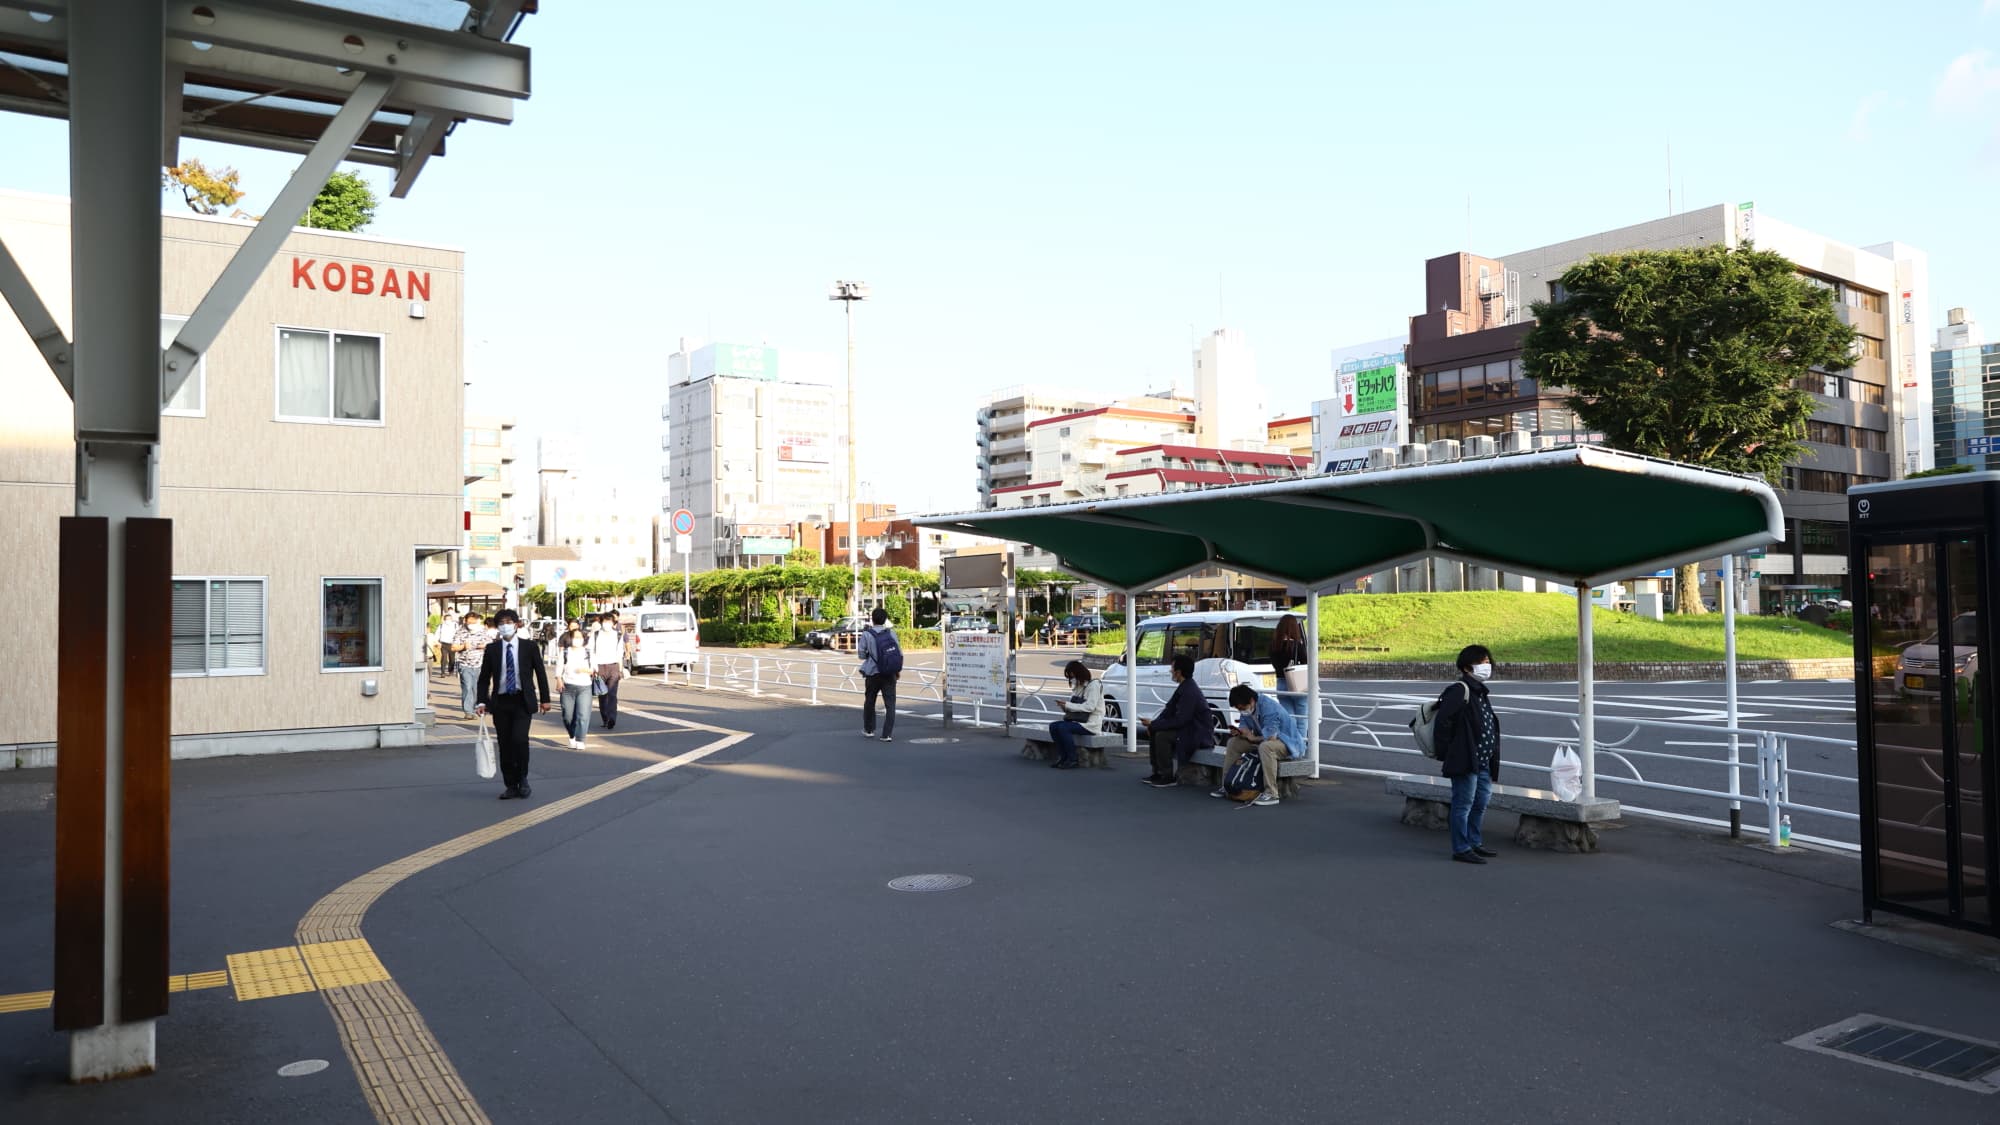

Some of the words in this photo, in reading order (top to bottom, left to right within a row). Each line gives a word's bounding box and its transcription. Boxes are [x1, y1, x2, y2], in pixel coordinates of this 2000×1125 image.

[293, 257, 430, 302] KOBAN
[1344, 384, 1353, 393] 1F
[1358, 374, 1397, 397] ピタットハウ
